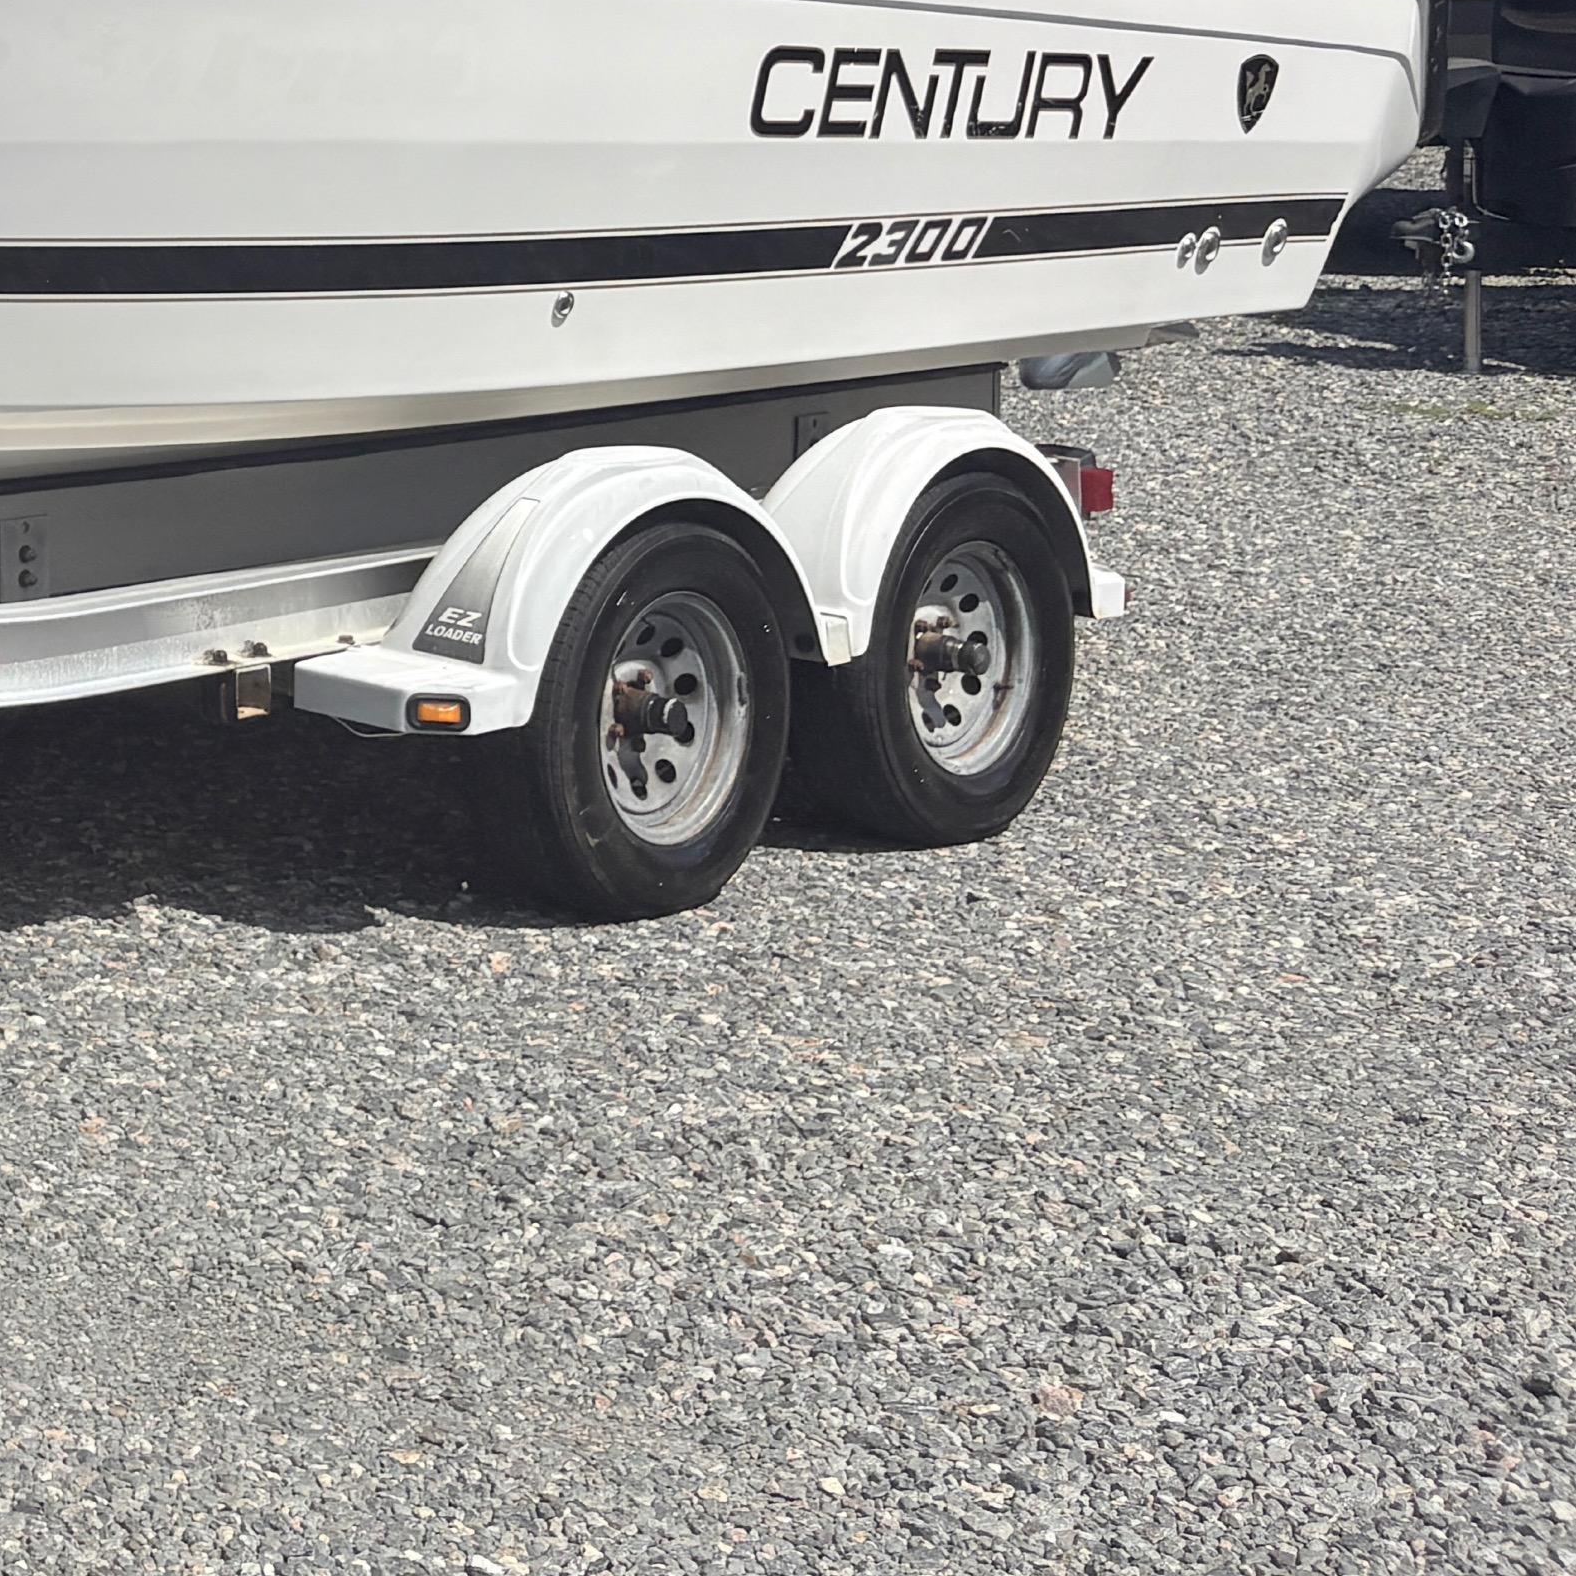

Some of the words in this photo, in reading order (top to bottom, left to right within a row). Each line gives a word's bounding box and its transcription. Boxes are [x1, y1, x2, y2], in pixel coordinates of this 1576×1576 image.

[750, 44, 1154, 140] CENTURY
[833, 216, 989, 270] 2300
[424, 623, 483, 645] LOADER
[438, 606, 483, 628] EZ
